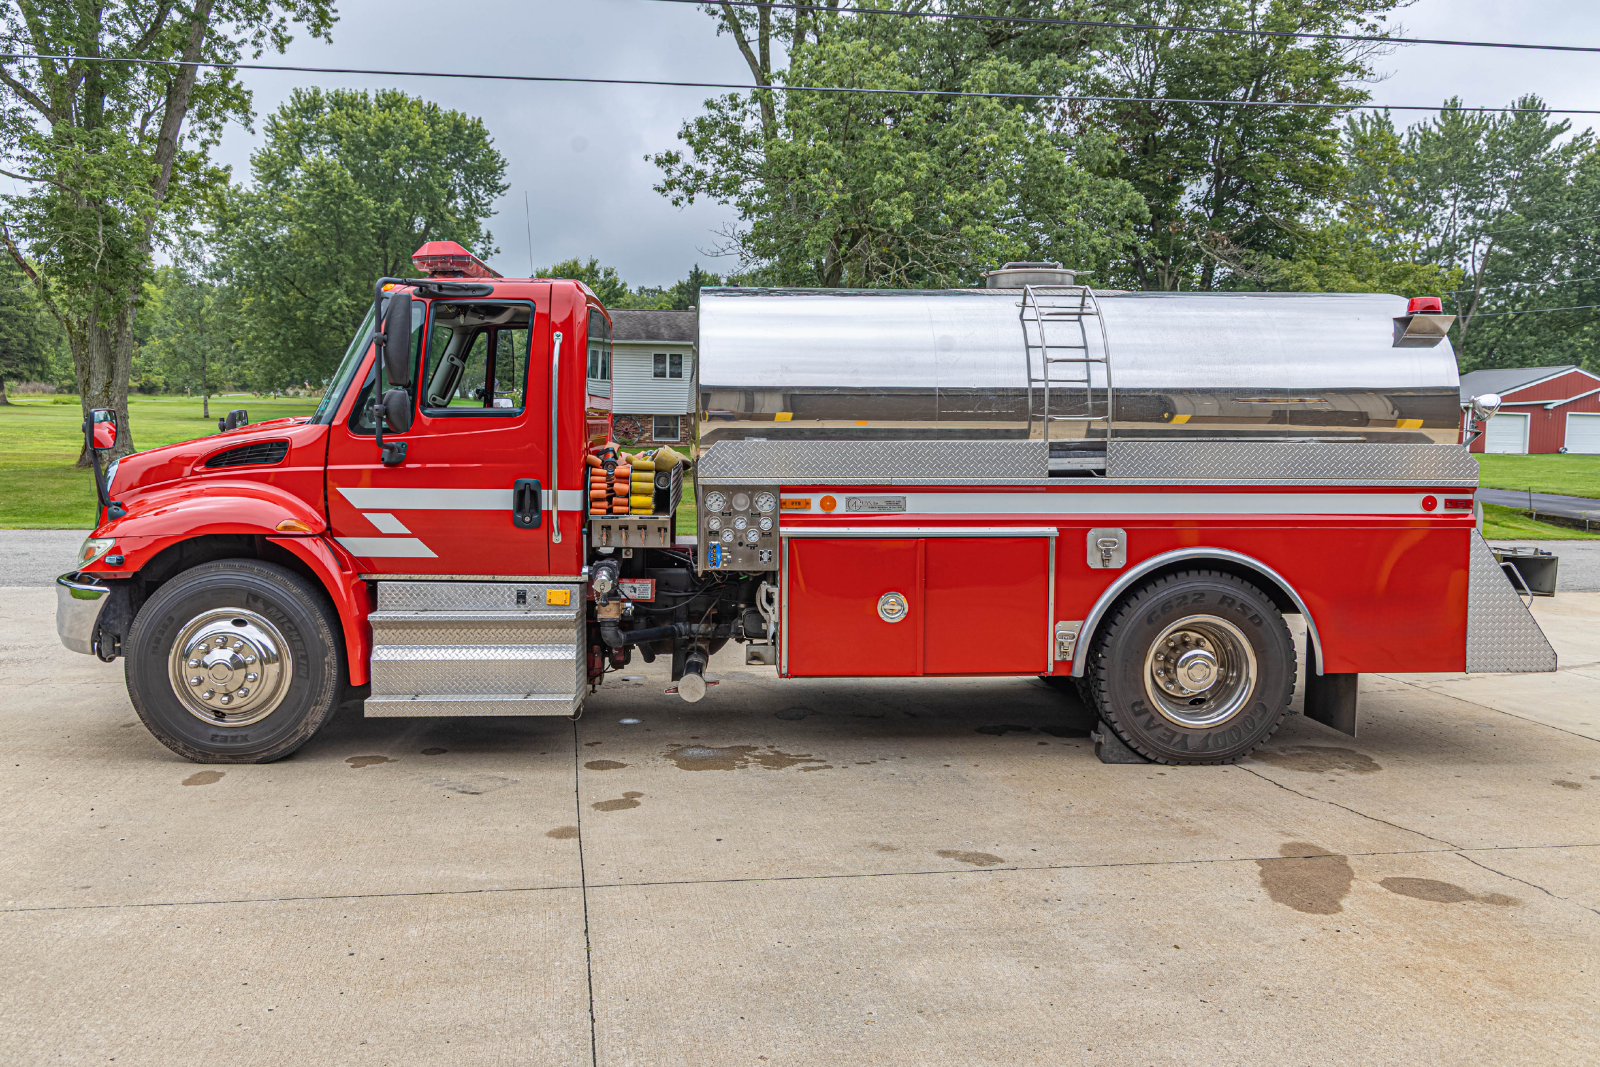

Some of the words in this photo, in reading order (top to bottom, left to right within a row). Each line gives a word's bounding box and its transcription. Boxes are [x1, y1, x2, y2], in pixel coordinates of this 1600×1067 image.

[1147, 592, 1206, 626] G622
[1217, 594, 1263, 628] RSD
[265, 606, 309, 680] MICHELIN
[209, 733, 250, 744] XZE2
